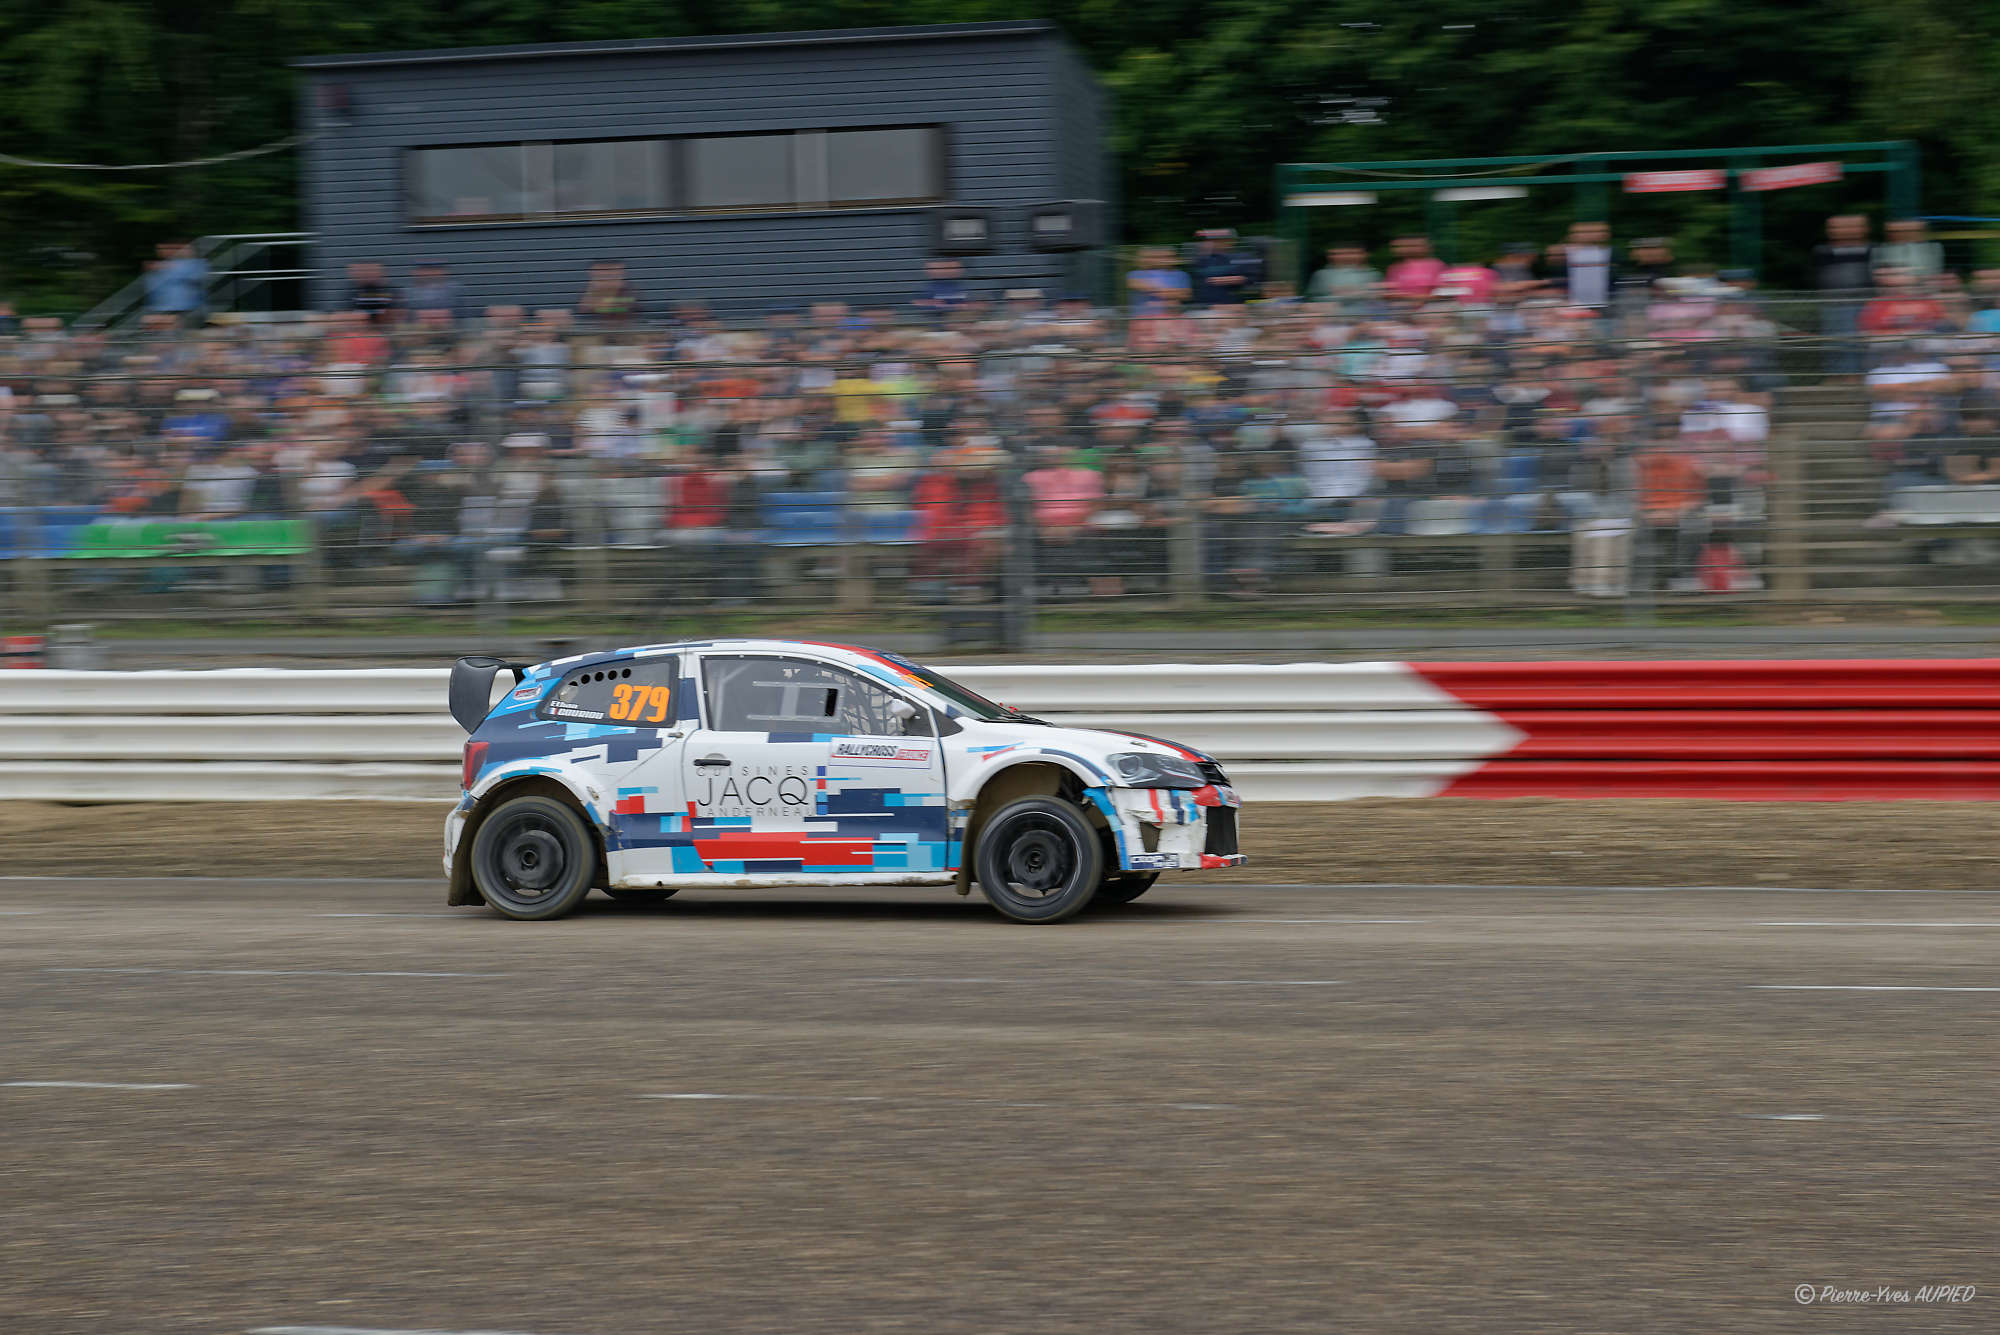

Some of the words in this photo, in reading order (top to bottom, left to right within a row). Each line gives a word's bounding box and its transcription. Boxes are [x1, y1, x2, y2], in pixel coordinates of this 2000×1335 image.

[609, 683, 670, 722] 379
[836, 743, 898, 757] RALLYCROSS
[696, 765, 808, 776] CUISINES
[697, 776, 809, 806] JACQ
